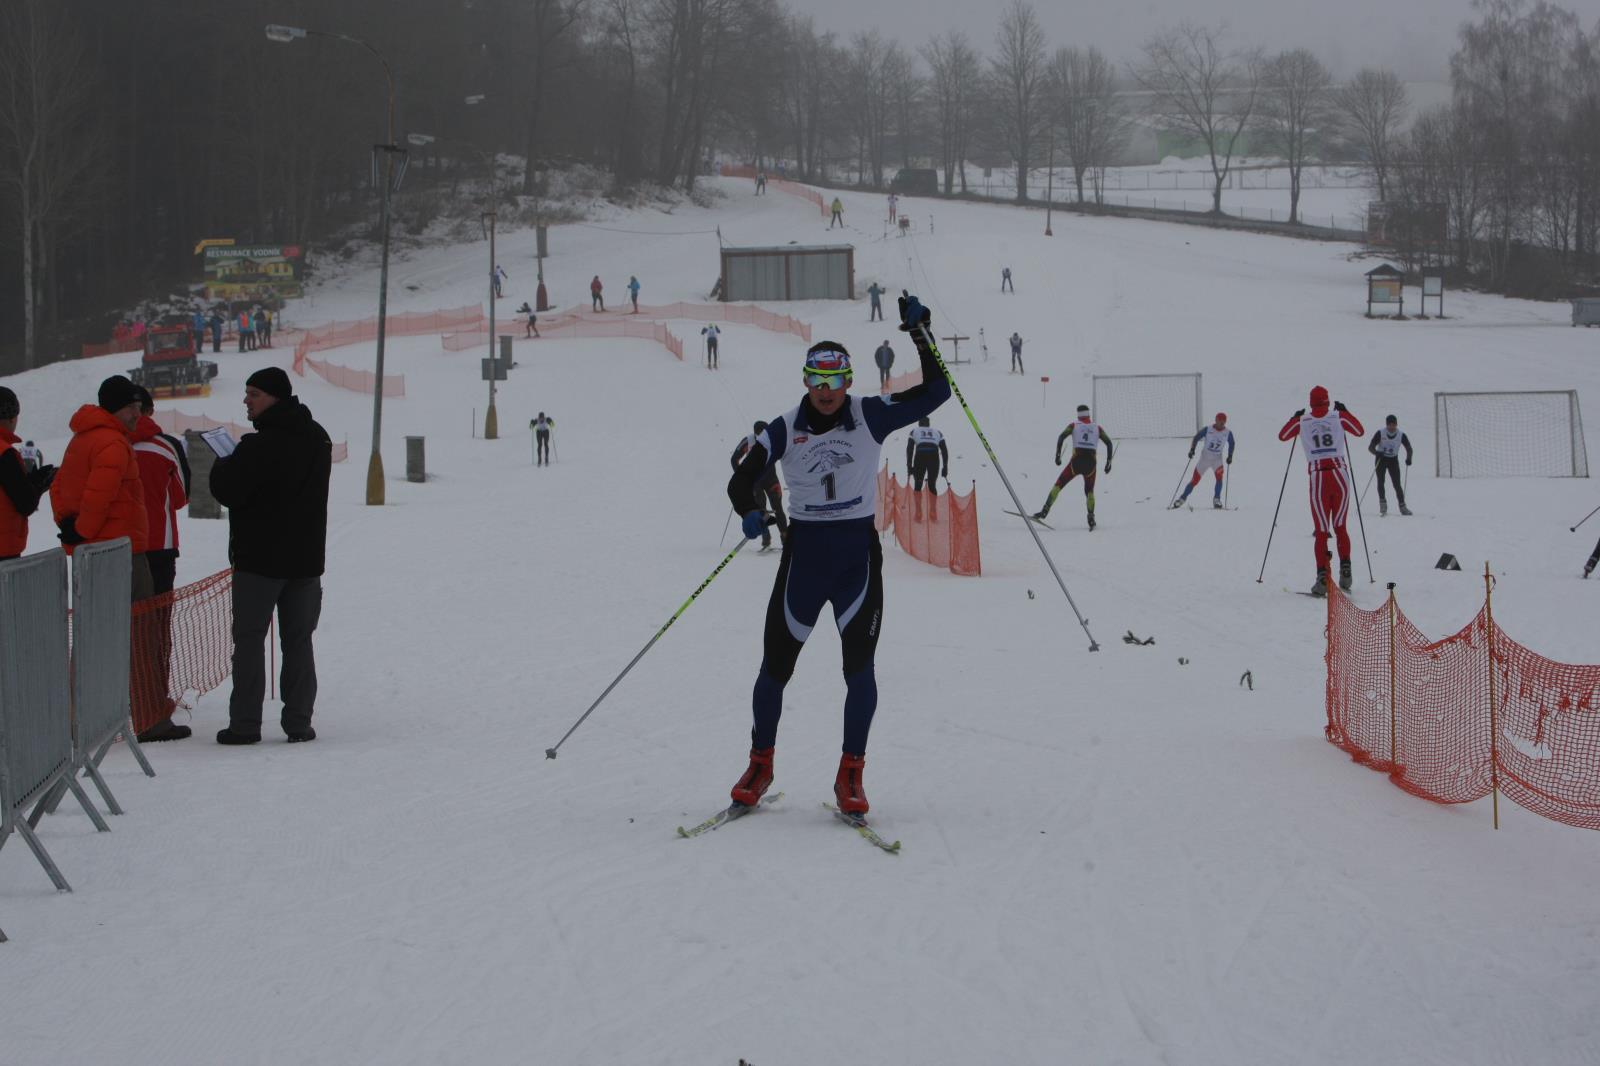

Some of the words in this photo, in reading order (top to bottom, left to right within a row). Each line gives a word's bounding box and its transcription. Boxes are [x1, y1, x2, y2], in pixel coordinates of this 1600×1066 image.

[829, 438, 854, 449] STACHY
[1312, 433, 1334, 448] 18
[820, 471, 837, 502] 1
[869, 611, 880, 637] CRAFT
